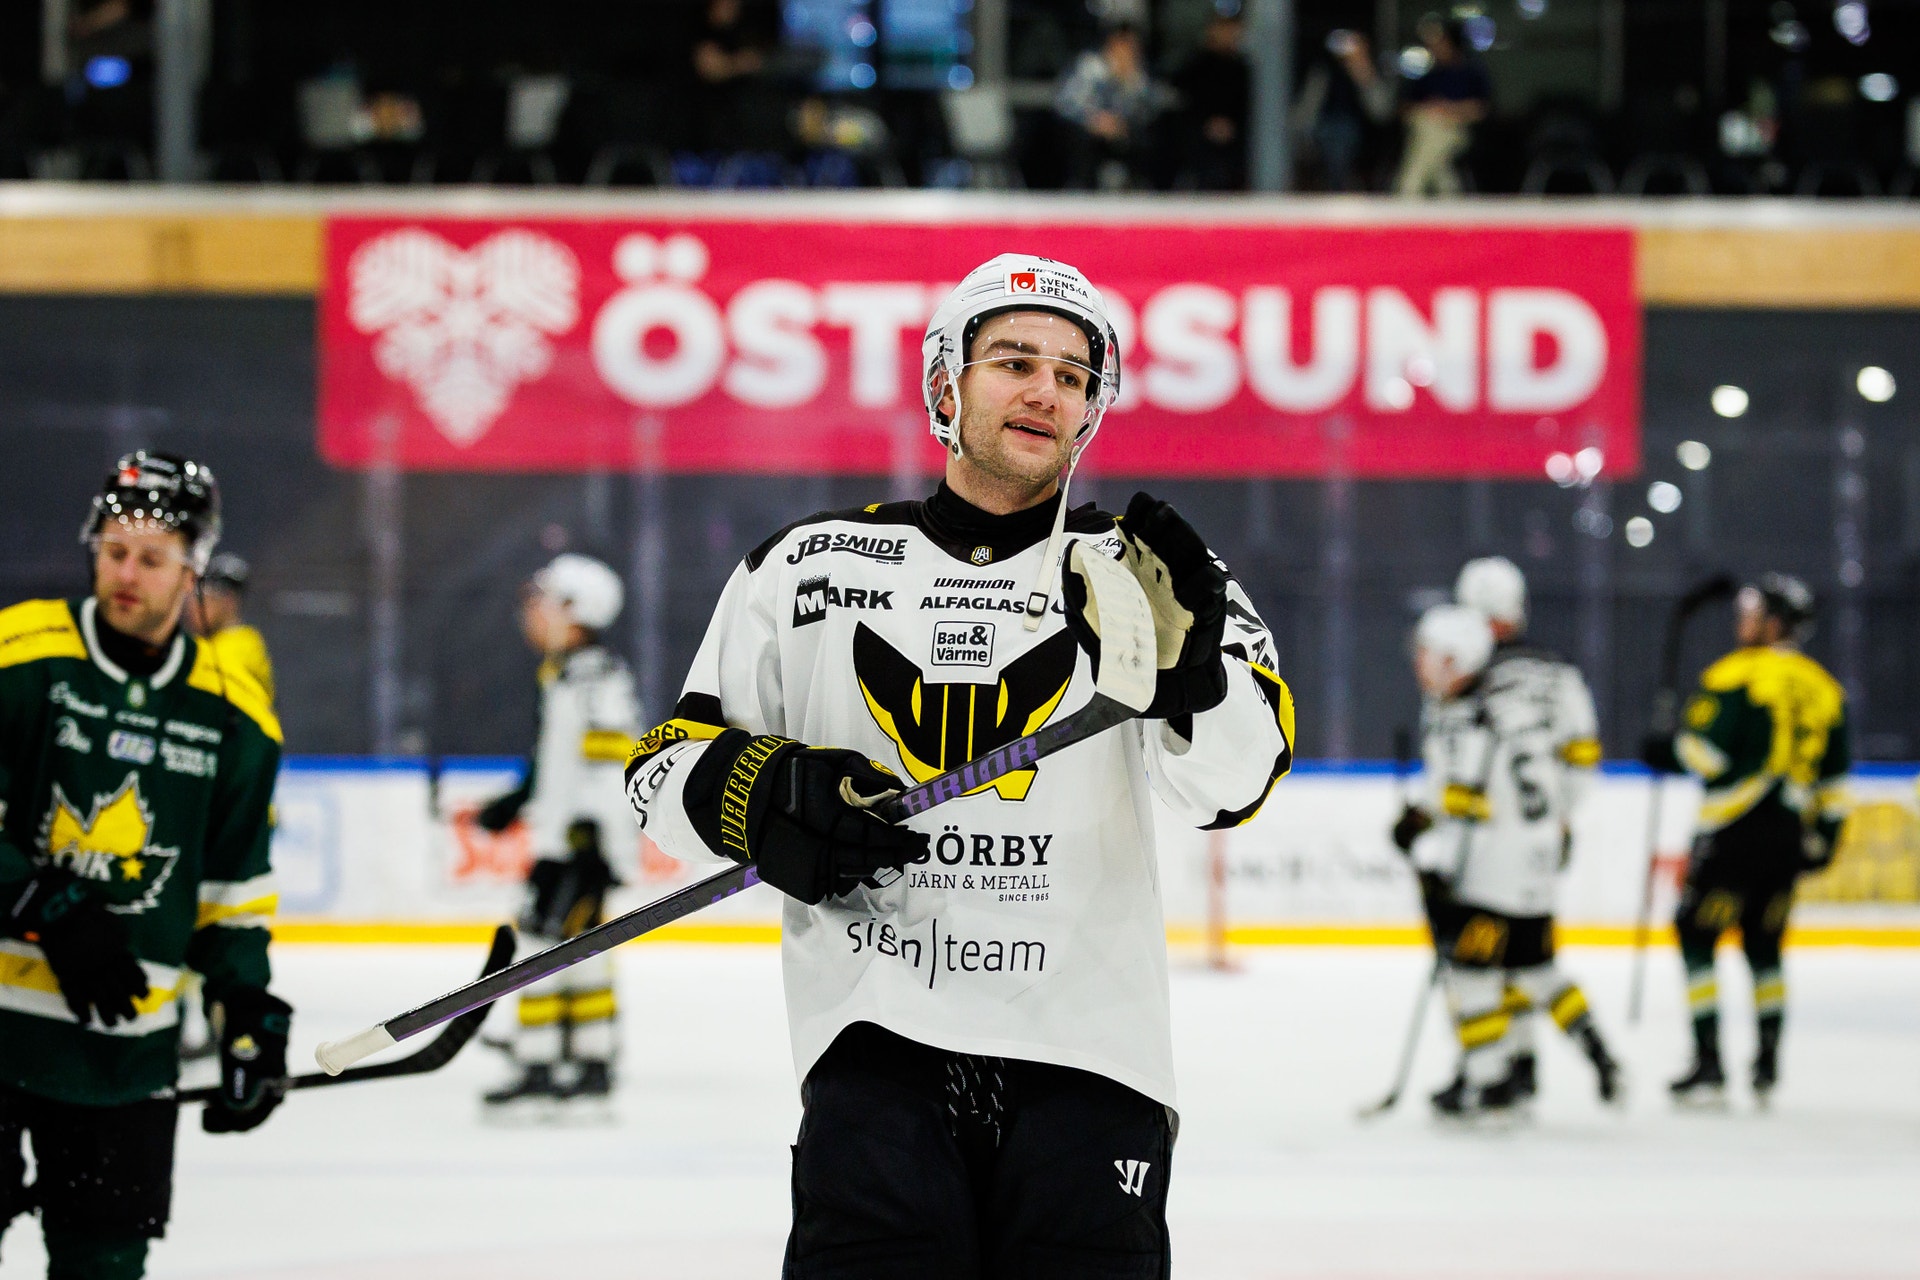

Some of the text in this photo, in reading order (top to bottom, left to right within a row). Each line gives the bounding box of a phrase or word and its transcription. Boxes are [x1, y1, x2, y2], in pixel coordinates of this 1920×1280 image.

[1039, 276, 1089, 299] SVENSKA
[1040, 285, 1068, 299] SPEL
[593, 232, 1609, 414] ÖSTSUND
[933, 577, 1016, 591] WARRIOR
[796, 586, 895, 617] MARK
[919, 596, 1026, 614] ALFAGLAS
[937, 625, 989, 646] Bad &
[936, 646, 988, 662] Värme
[901, 736, 1039, 816] RRIOR
[720, 734, 800, 860] WARRIO
[909, 870, 1050, 890] JÄRN & METALL
[998, 892, 1049, 902] SINCE 1965
